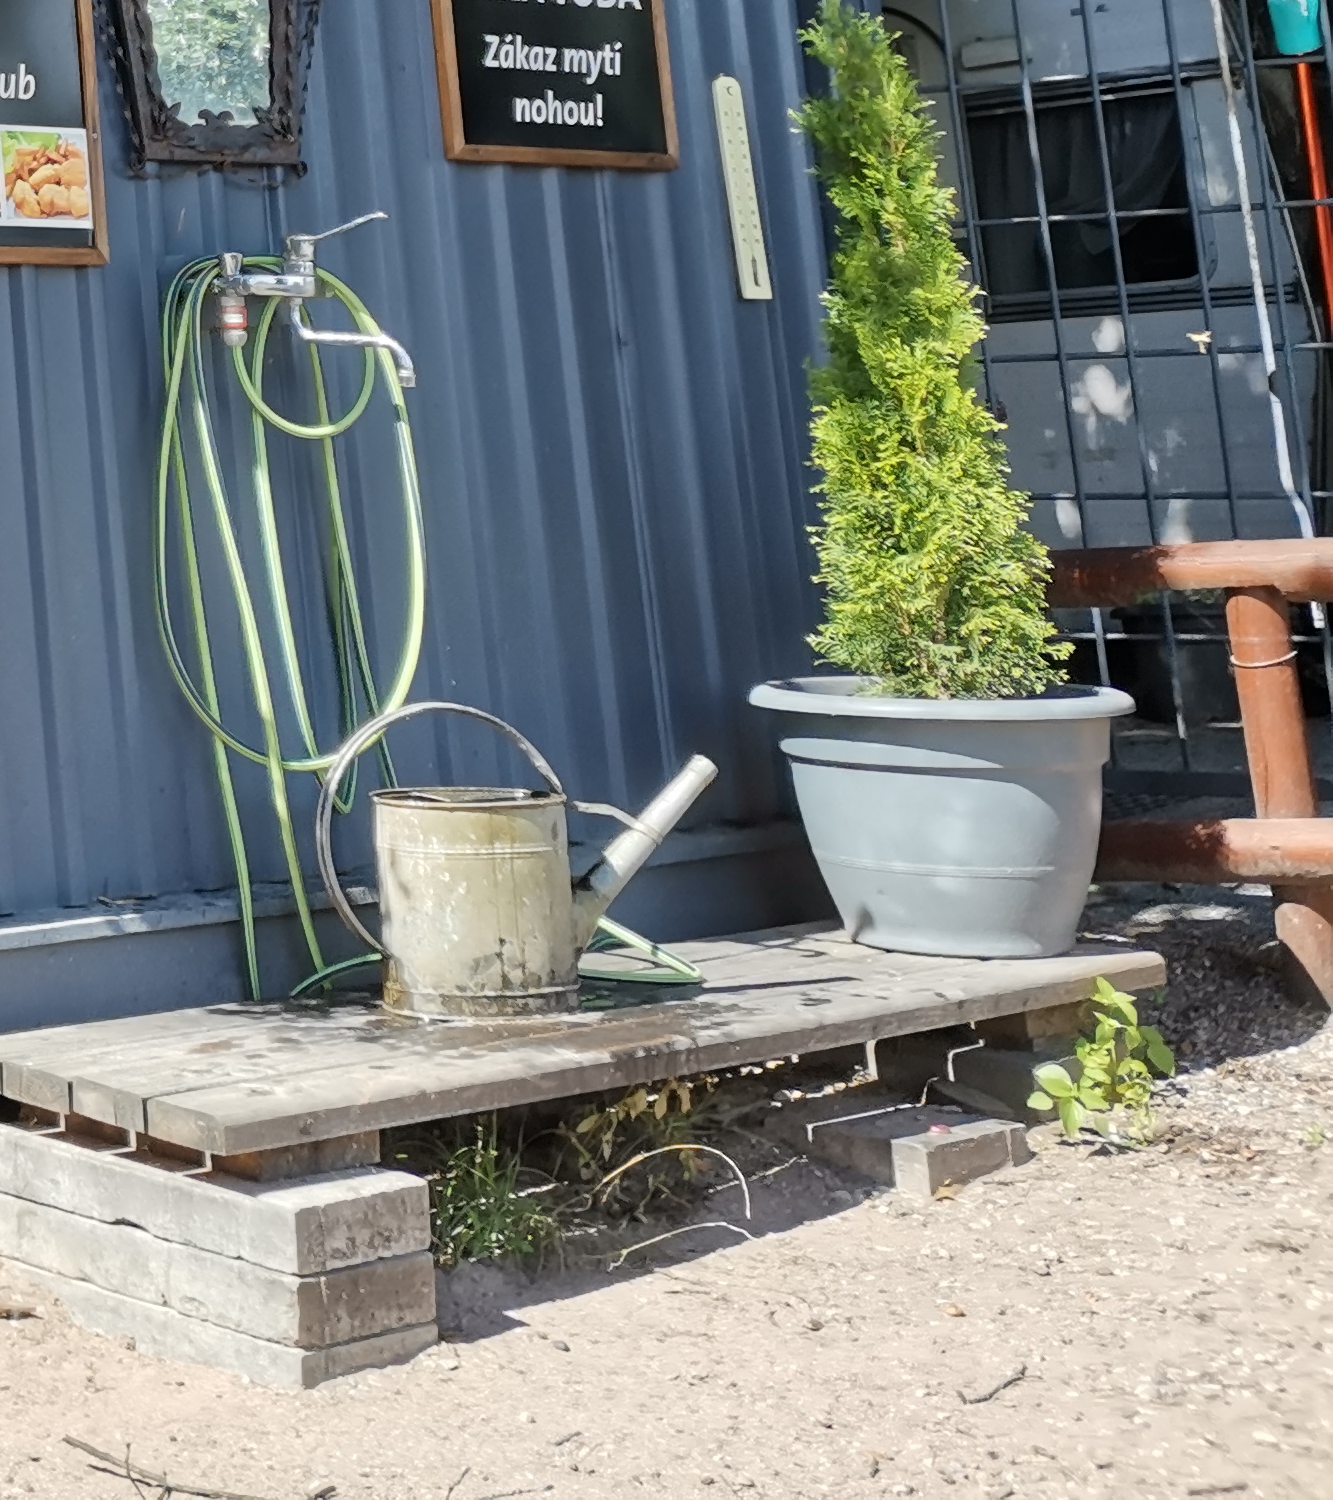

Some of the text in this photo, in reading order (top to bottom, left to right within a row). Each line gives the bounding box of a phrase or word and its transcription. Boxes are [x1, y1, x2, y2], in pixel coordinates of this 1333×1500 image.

[484, 34, 622, 85] Zákaz mytí
[515, 90, 604, 127] nohou!
